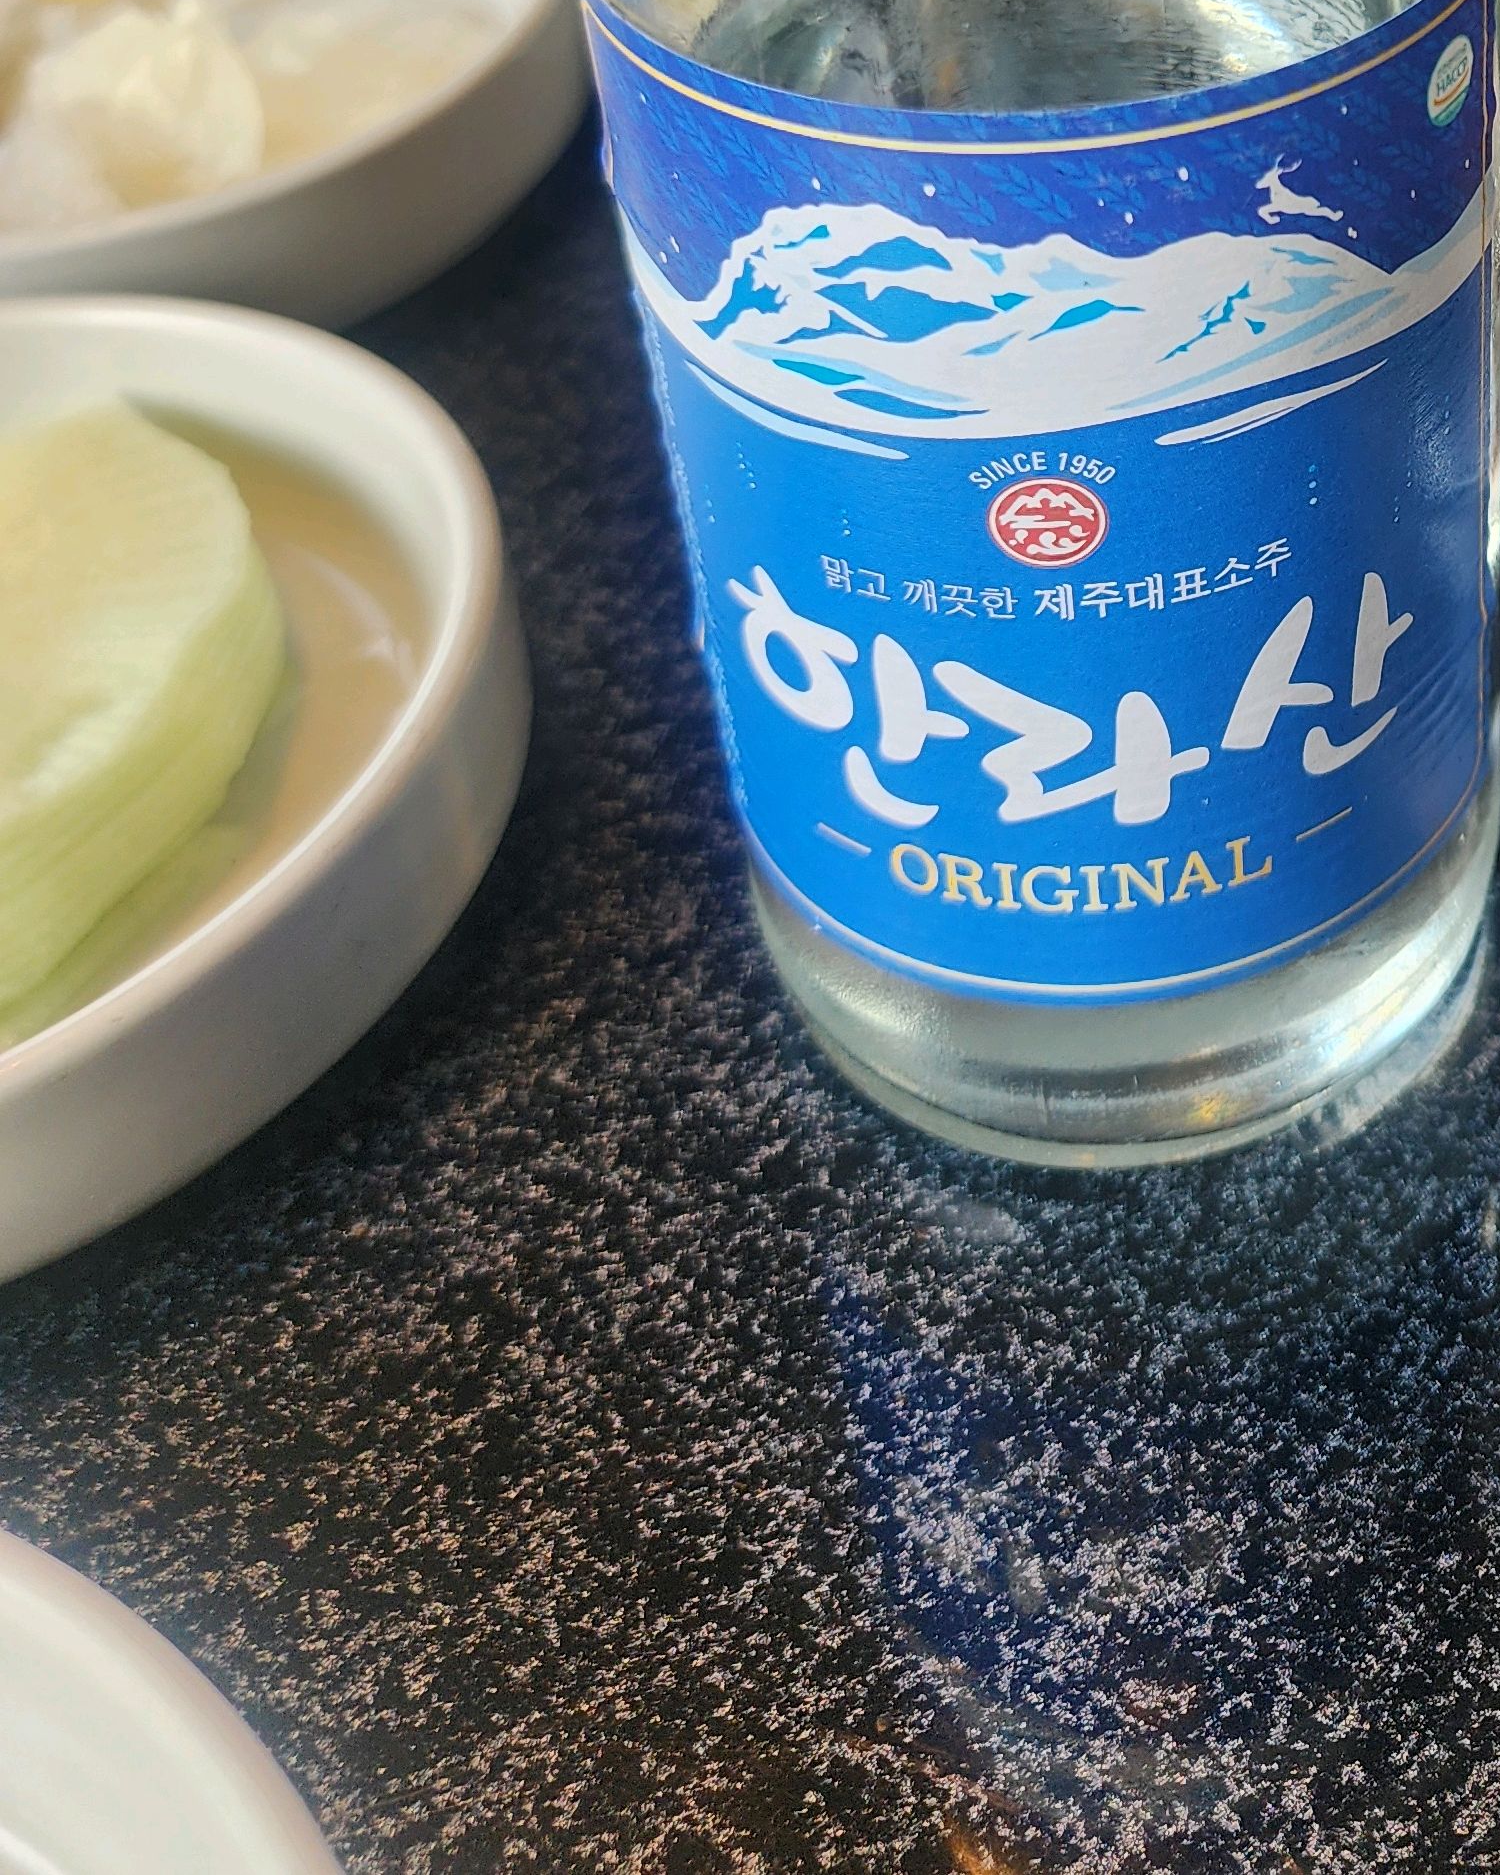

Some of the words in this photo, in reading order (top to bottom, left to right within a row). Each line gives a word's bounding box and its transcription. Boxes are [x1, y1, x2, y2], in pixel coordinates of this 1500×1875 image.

[968, 451, 1047, 491] SINCE
[1058, 451, 1117, 486] 1950
[820, 554, 892, 602] 맑고
[902, 579, 1018, 620] 깨끗한
[1034, 537, 1293, 621] 제주대표소주
[727, 564, 1414, 827] 한라산
[889, 834, 1274, 913] ORIGINAL
